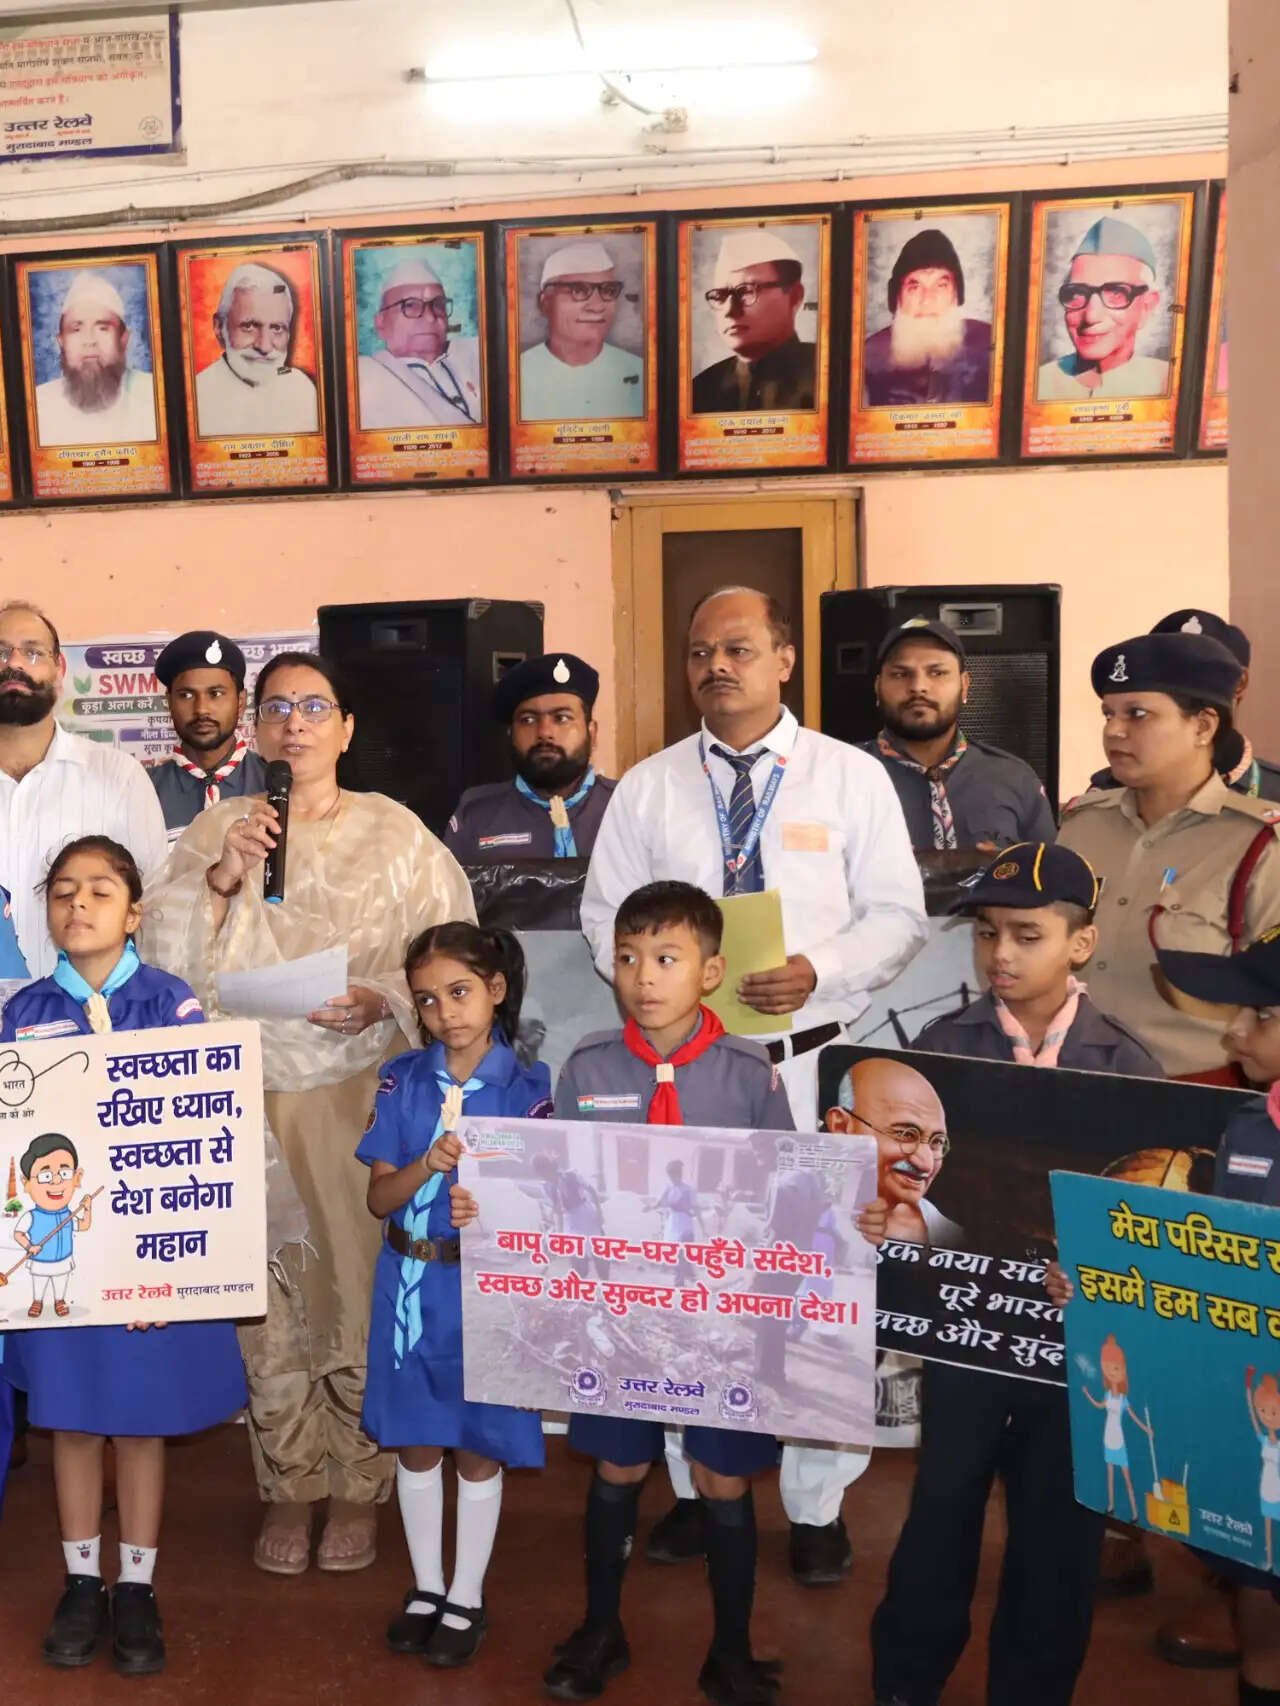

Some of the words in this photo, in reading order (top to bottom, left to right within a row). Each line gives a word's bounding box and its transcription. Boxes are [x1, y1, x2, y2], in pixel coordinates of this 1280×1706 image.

[4, 119, 49, 133] उत्तर
[53, 113, 93, 129] रेलवे
[6, 140, 55, 153] मुरादाबाद
[101, 648, 146, 666] स्वच्छ
[98, 672, 159, 695] SWM
[106, 699, 135, 711] अलग
[143, 744, 162, 756] सूखा
[106, 1048, 198, 1083] स्वच्छता
[204, 1044, 243, 1074] का
[2, 1079, 26, 1091] भारत
[96, 1086, 166, 1129] रखिए
[171, 1089, 244, 1122] ध्यान,
[108, 1136, 202, 1172] स्वच्छता
[209, 1126, 235, 1164] से
[110, 1179, 158, 1217] देश
[160, 1174, 235, 1214] बनेगा
[136, 1228, 209, 1264] महान
[496, 1229, 548, 1266] बापू
[549, 1232, 585, 1258] का
[592, 1235, 680, 1266] घर-घर
[684, 1236, 747, 1279] पहुँचे
[753, 1240, 834, 1279] संदेश,
[1107, 1199, 1160, 1249] मेरा
[1164, 1210, 1261, 1274] परिसर
[928, 1246, 992, 1276] नया
[998, 1253, 1050, 1286] सवे
[101, 1285, 133, 1302] उत्तर
[137, 1282, 174, 1300] रेलवे
[176, 1285, 221, 1298] मुरादाबाद
[223, 1281, 255, 1294] मण्डल
[476, 1270, 545, 1298] स्वच्छ
[548, 1270, 597, 1301] और
[603, 1282, 675, 1316] सुन्दर
[680, 1283, 711, 1313] हो
[716, 1290, 794, 1320] अपना
[800, 1292, 860, 1327] देश।
[937, 1280, 980, 1315] पूरे
[986, 1291, 1065, 1325] भारत
[1076, 1262, 1146, 1311] इसमे
[1150, 1279, 1201, 1322] हम
[1206, 1291, 1261, 1340] सब
[876, 1307, 933, 1339] वच्छ
[935, 1318, 1005, 1354] और
[1007, 1332, 1067, 1368] सुंद
[618, 1376, 659, 1393] उत्तर
[663, 1377, 706, 1399] रेलवे
[623, 1400, 669, 1412] मुरादाबाद
[670, 1404, 700, 1416] मण्डल
